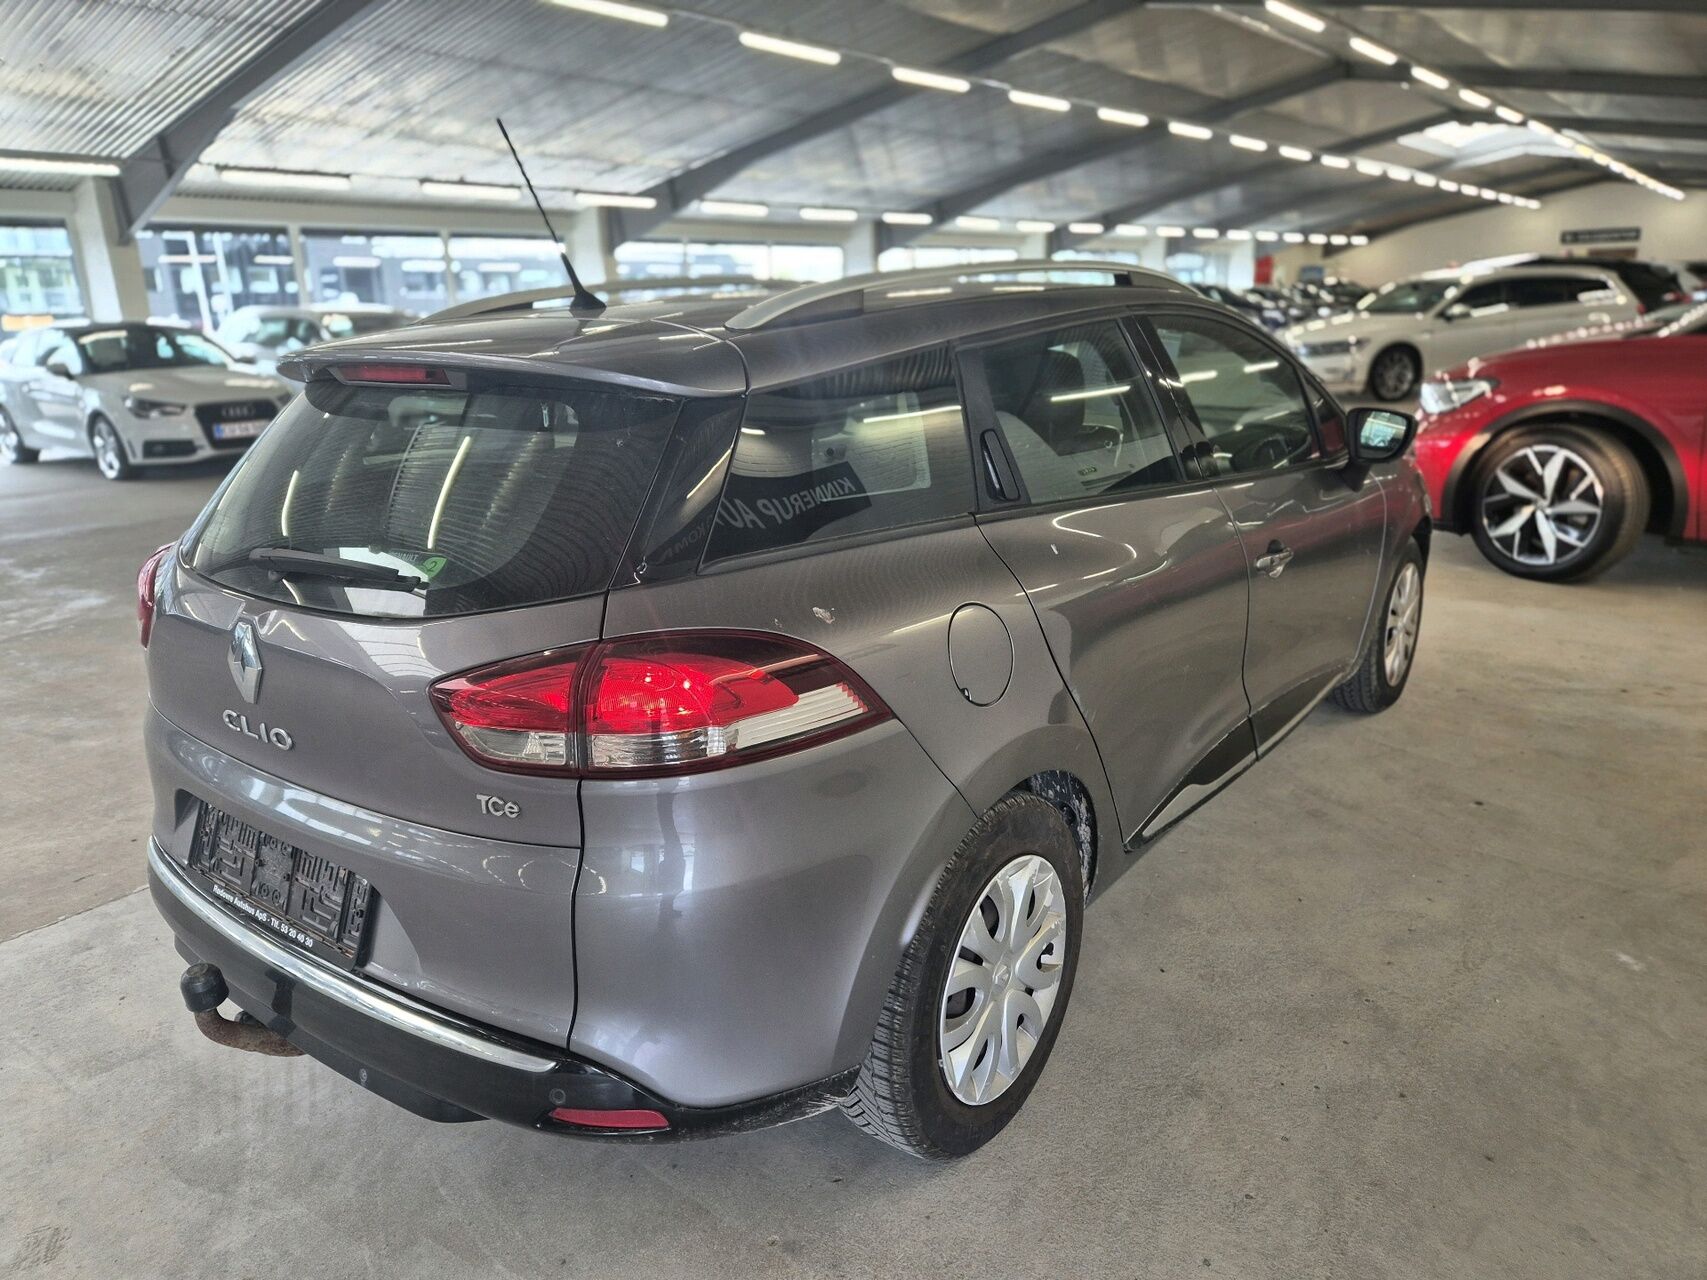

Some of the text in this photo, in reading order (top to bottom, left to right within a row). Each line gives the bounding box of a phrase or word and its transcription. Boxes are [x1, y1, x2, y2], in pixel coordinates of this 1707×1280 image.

[222, 709, 293, 751] CLIO
[476, 794, 521, 818] TCe
[254, 909, 267, 922] ApS
[288, 928, 297, 939] 20
